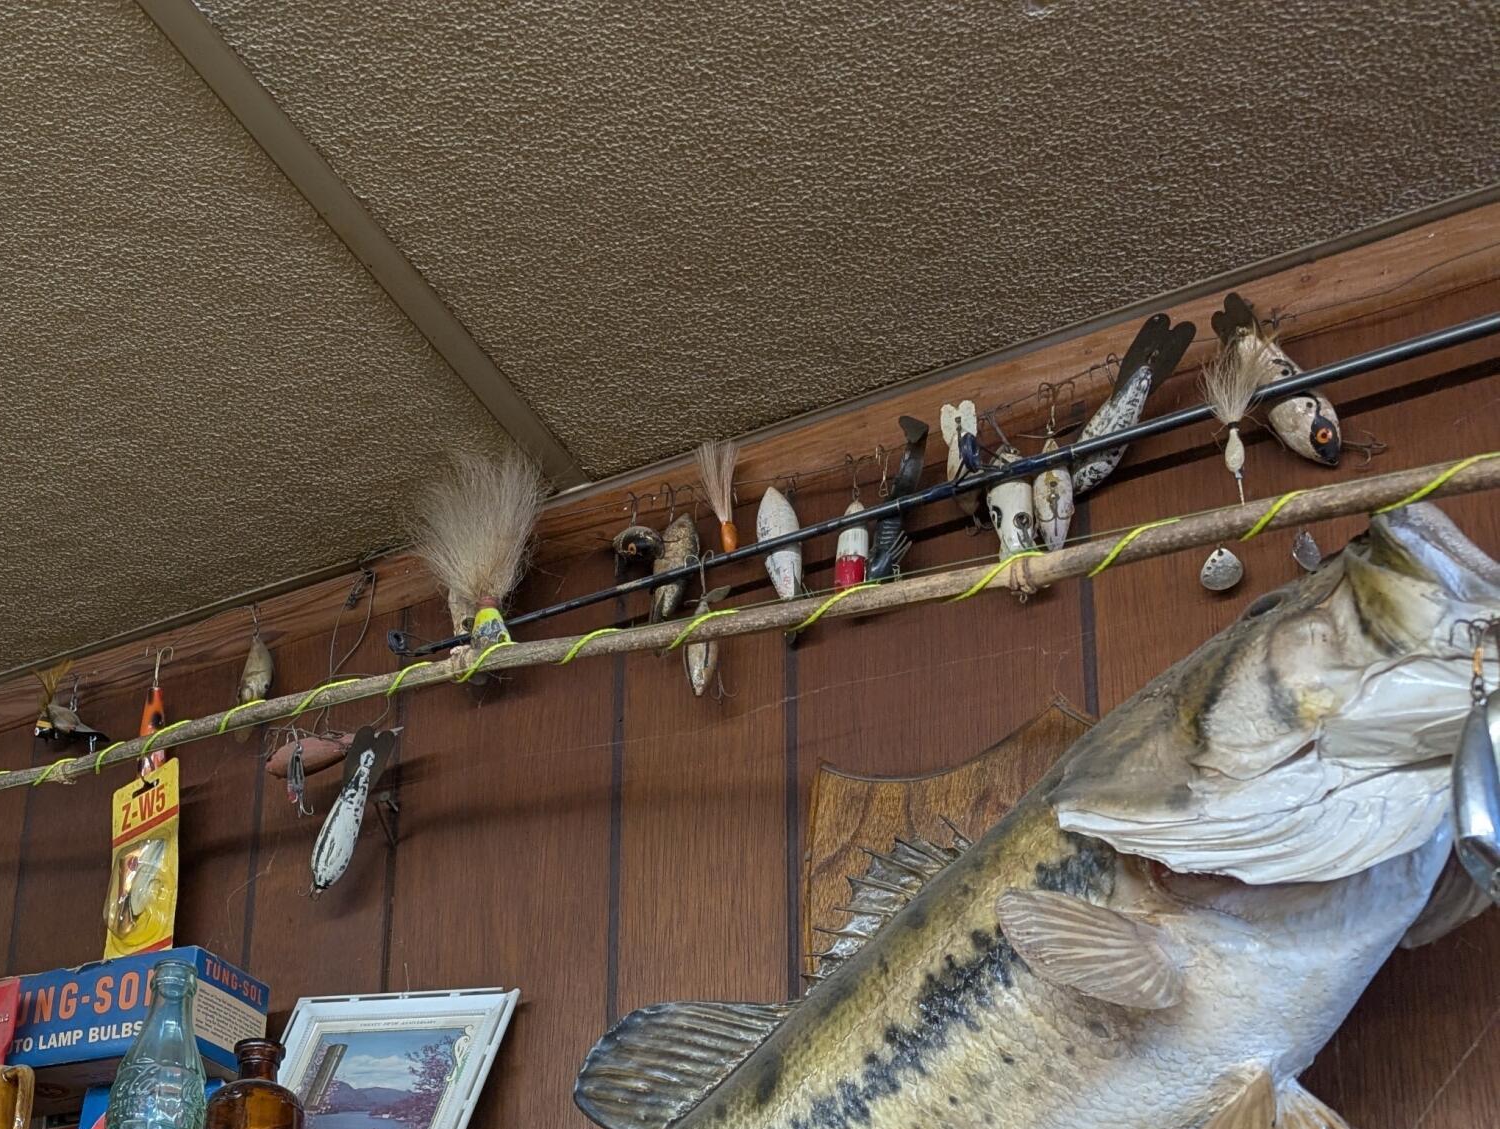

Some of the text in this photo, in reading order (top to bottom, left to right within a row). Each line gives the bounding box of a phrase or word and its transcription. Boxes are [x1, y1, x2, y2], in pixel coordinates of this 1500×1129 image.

[122, 784, 166, 832] Z-W5
[205, 958, 262, 1006] TUNG-SOL
[38, 1031, 84, 1050] LAMP
[88, 1021, 144, 1043] BULBS
